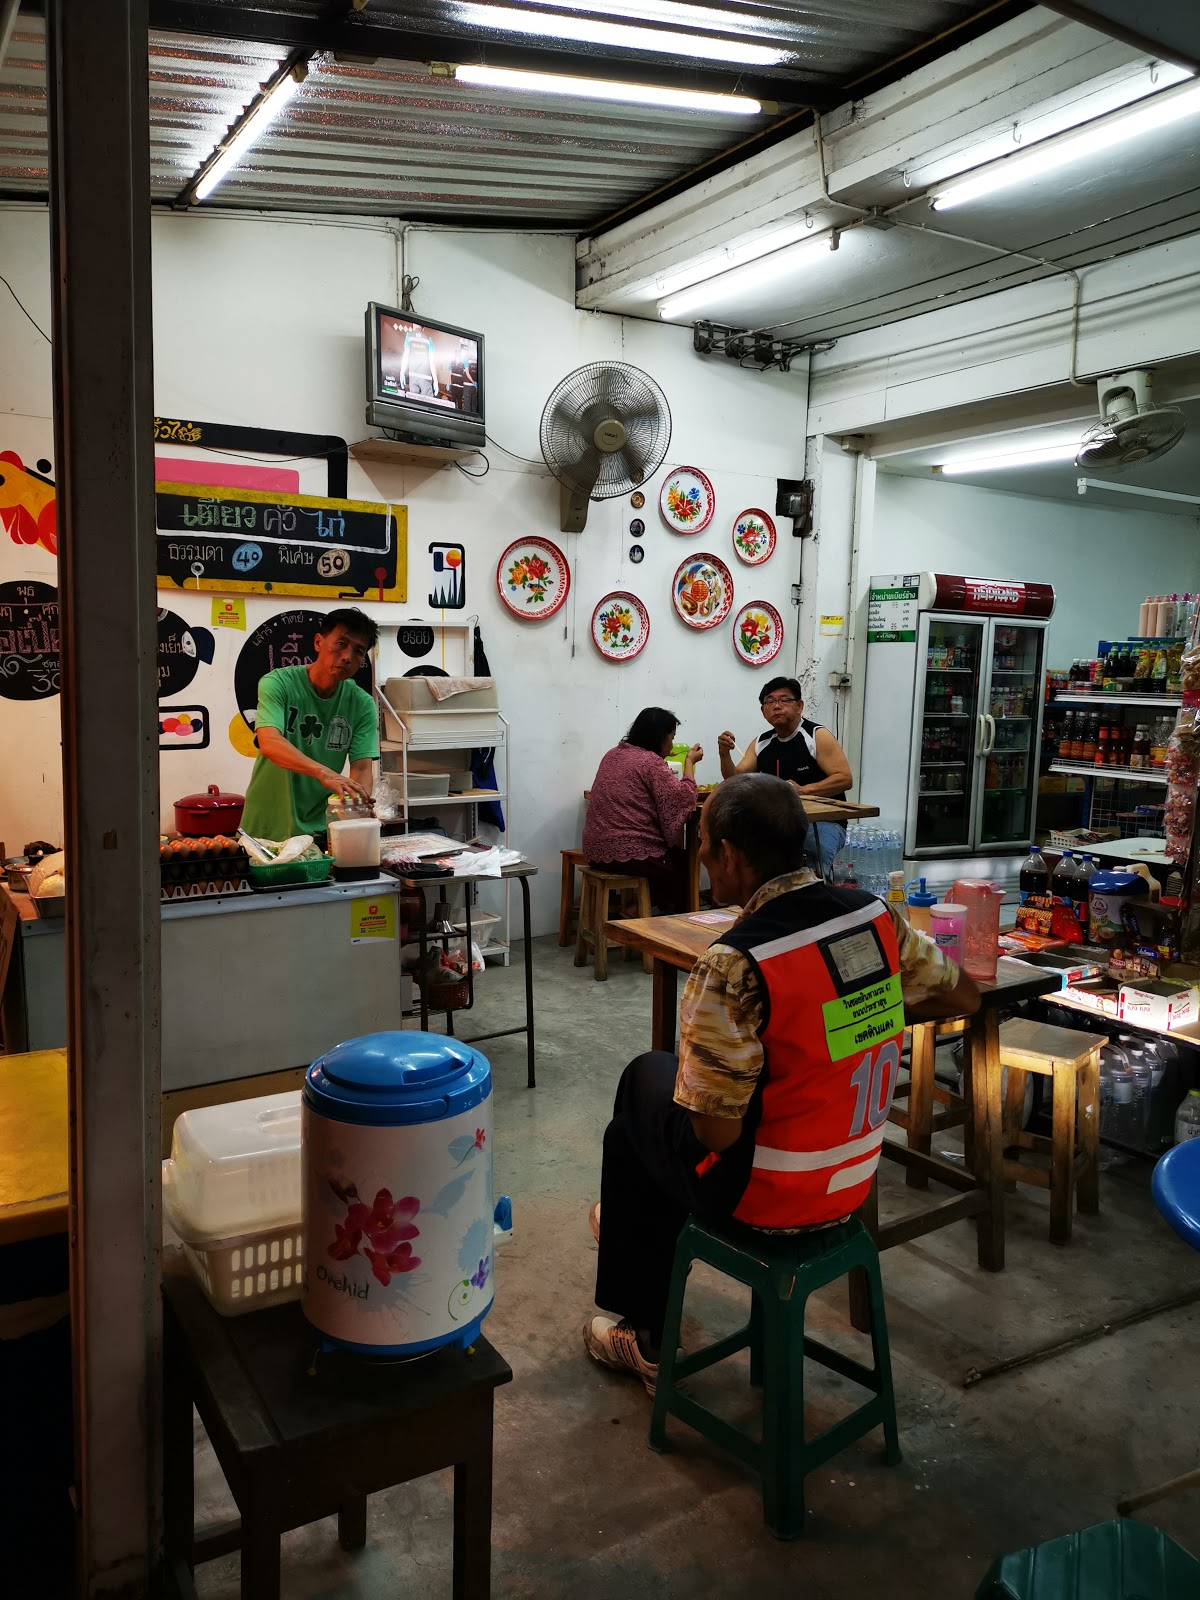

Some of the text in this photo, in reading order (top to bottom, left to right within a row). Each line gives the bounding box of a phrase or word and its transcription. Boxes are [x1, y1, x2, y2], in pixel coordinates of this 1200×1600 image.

[168, 543, 344, 574] ธรรมดา 40 พิเศษ 50
[16, 586, 35, 605] พุธ
[252, 624, 273, 647] เสาร์
[854, 1018, 894, 1044] เขตดินแดง
[849, 1040, 900, 1139] 10
[315, 1265, 370, 1301] Orchid
